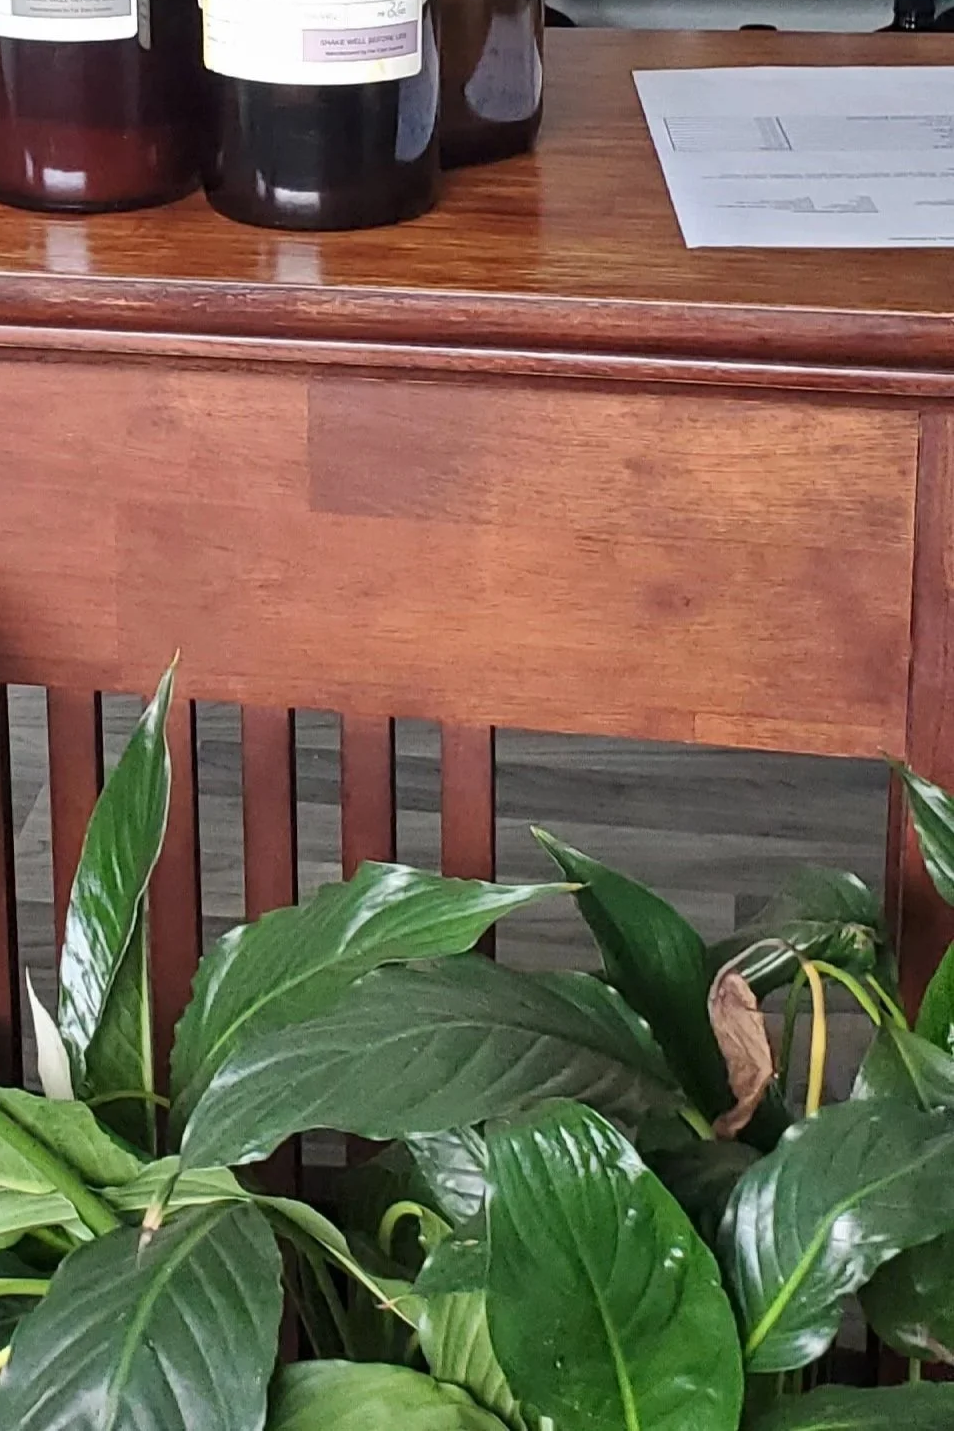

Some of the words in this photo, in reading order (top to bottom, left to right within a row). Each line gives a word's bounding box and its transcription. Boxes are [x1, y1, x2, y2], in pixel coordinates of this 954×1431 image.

[319, 38, 345, 47] SHAKE
[347, 36, 367, 46] WELL
[368, 34, 394, 45] BEFORE
